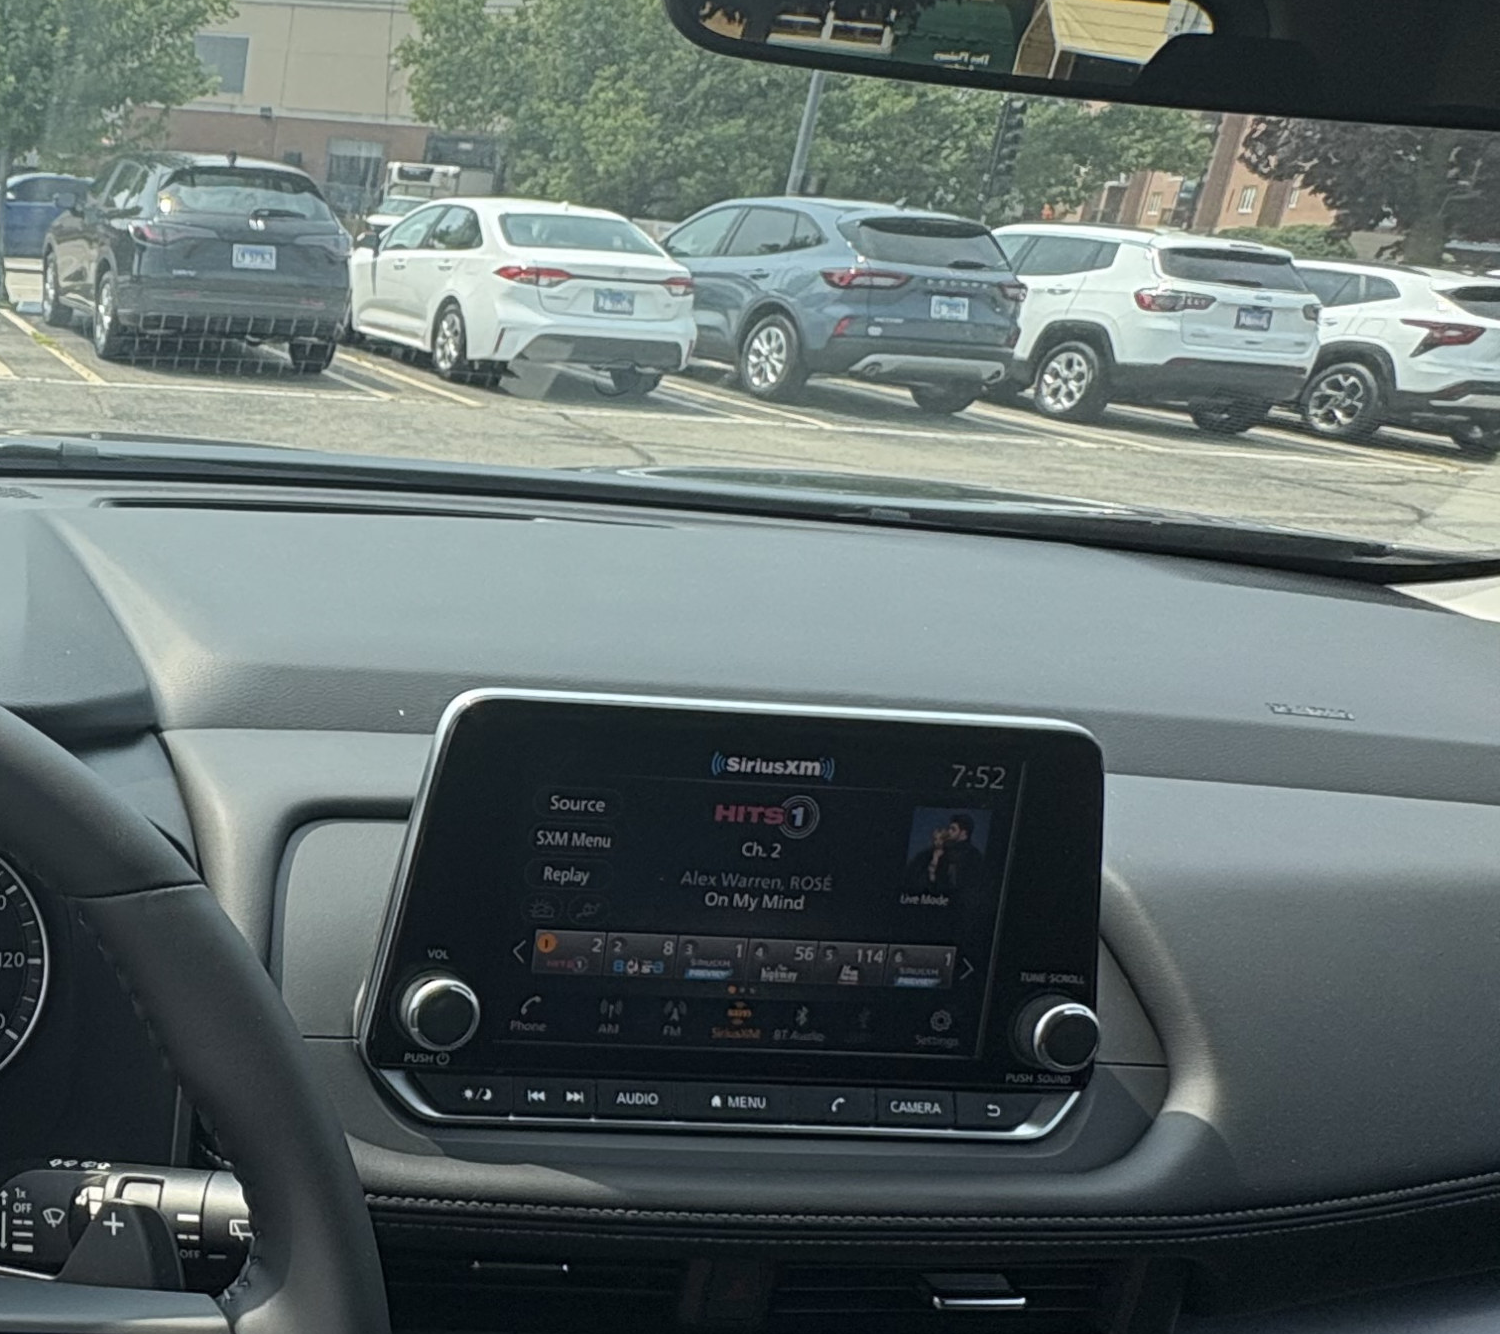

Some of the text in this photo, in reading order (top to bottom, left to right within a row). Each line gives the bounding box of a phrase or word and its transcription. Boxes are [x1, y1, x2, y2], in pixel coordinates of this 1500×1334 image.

[950, 763, 1007, 790] 7:52
[549, 795, 606, 813] Source
[535, 830, 612, 848] SXM Menu
[742, 841, 782, 858] Ch. 2
[543, 866, 590, 886] Replay
[680, 870, 833, 892] Alex Warren, ROSÉ
[705, 891, 806, 912] On My Mind
[591, 938, 603, 953] 2
[613, 940, 674, 956] 2 8
[685, 943, 743, 959] 3 1
[427, 949, 449, 960] VOL
[755, 946, 815, 961] 4 56
[824, 949, 884, 964] 5 114
[510, 1020, 547, 1032] Phone
[662, 1024, 682, 1037] FM
[404, 1053, 434, 1063] PUSH
[1005, 1073, 1071, 1085] PUSH SOUND
[615, 1091, 659, 1106] AUDIO
[727, 1095, 767, 1110] MENU
[889, 1099, 942, 1115] CAMERA
[14, 1187, 26, 1199] 1x
[12, 1202, 33, 1214] OFF
[179, 1249, 200, 1259] OFF
